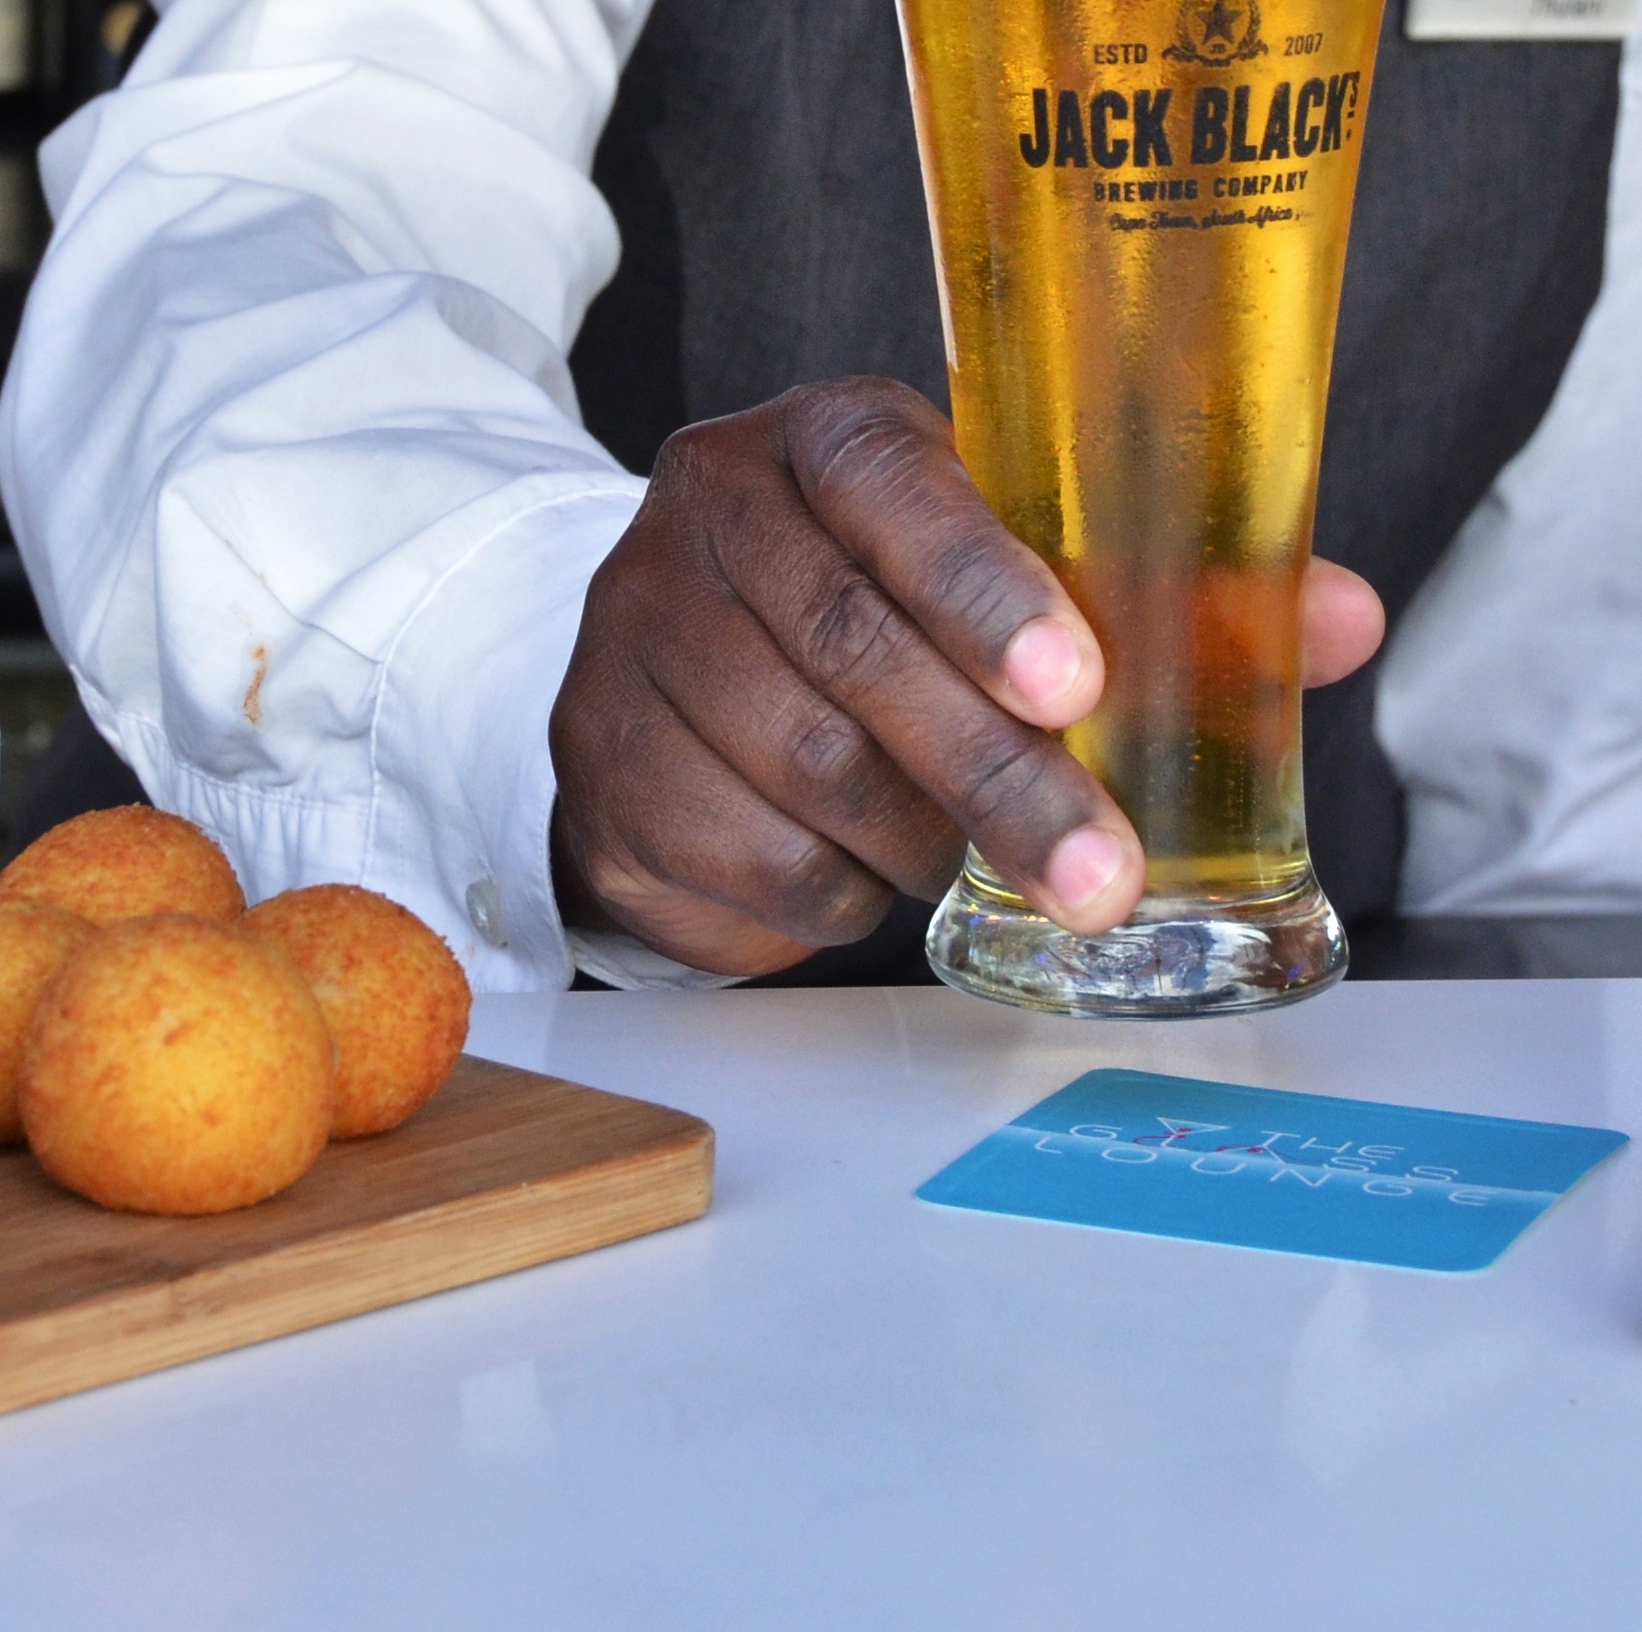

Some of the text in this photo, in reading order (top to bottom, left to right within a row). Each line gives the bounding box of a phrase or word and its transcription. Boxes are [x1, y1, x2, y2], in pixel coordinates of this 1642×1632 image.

[1093, 32, 1324, 66] ESTD 2007
[1018, 88, 1174, 169] JACK
[1093, 171, 1309, 203] BREWING COMPANY
[1260, 1129, 1405, 1161] THE
[1034, 1136, 1499, 1207] LOUNGE
